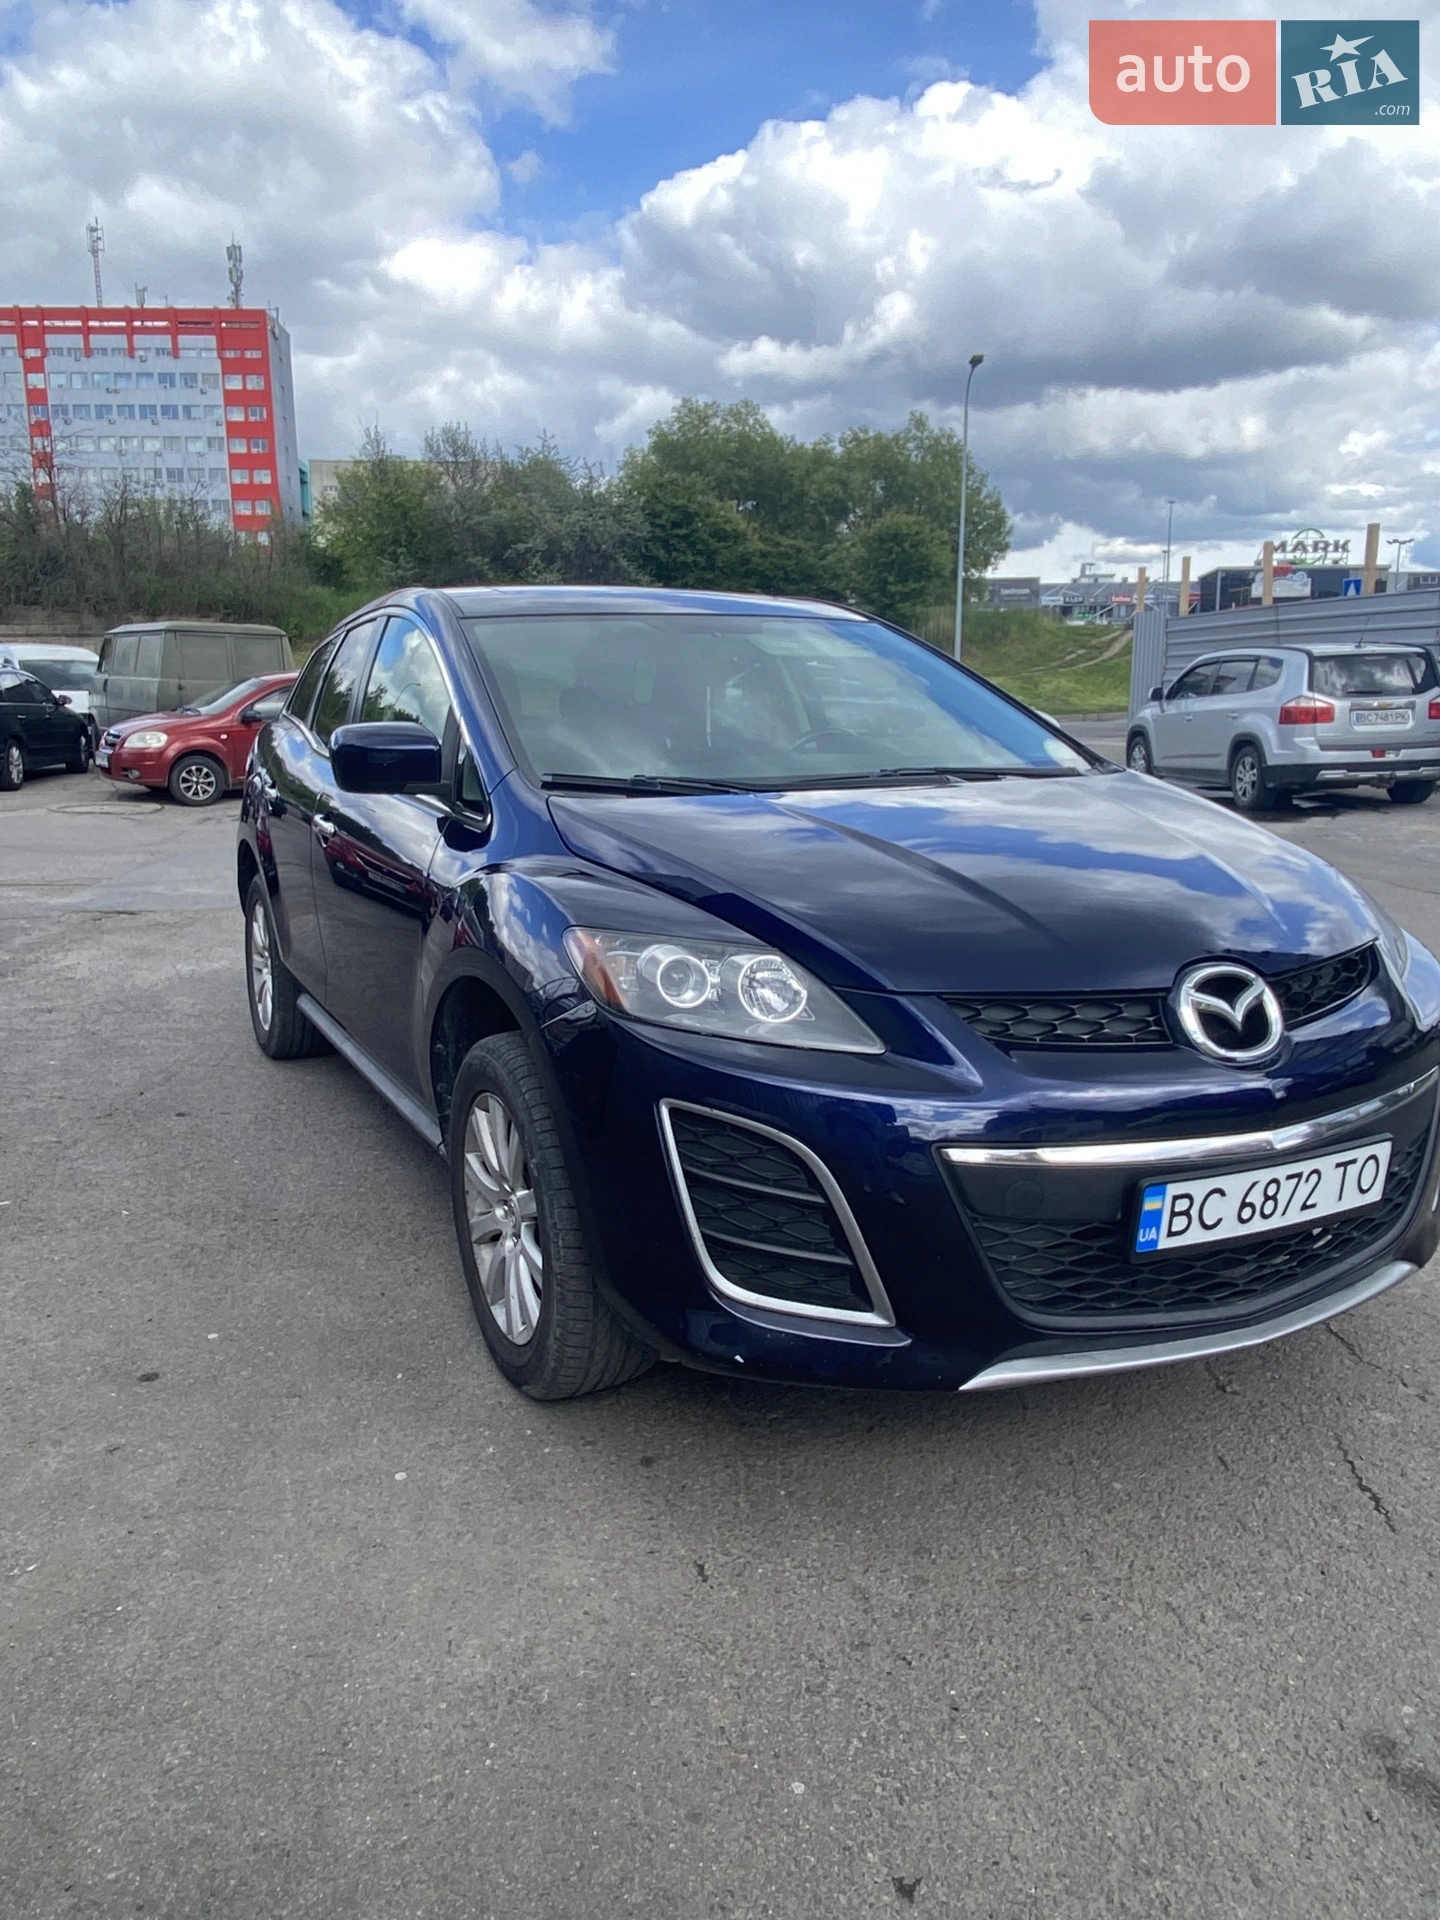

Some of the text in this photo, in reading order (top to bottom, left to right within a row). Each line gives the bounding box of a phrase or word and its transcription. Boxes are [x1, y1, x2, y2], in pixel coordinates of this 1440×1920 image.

[1166, 1154, 1380, 1238] BC 6872 TO
[1139, 1226, 1158, 1242] UA
